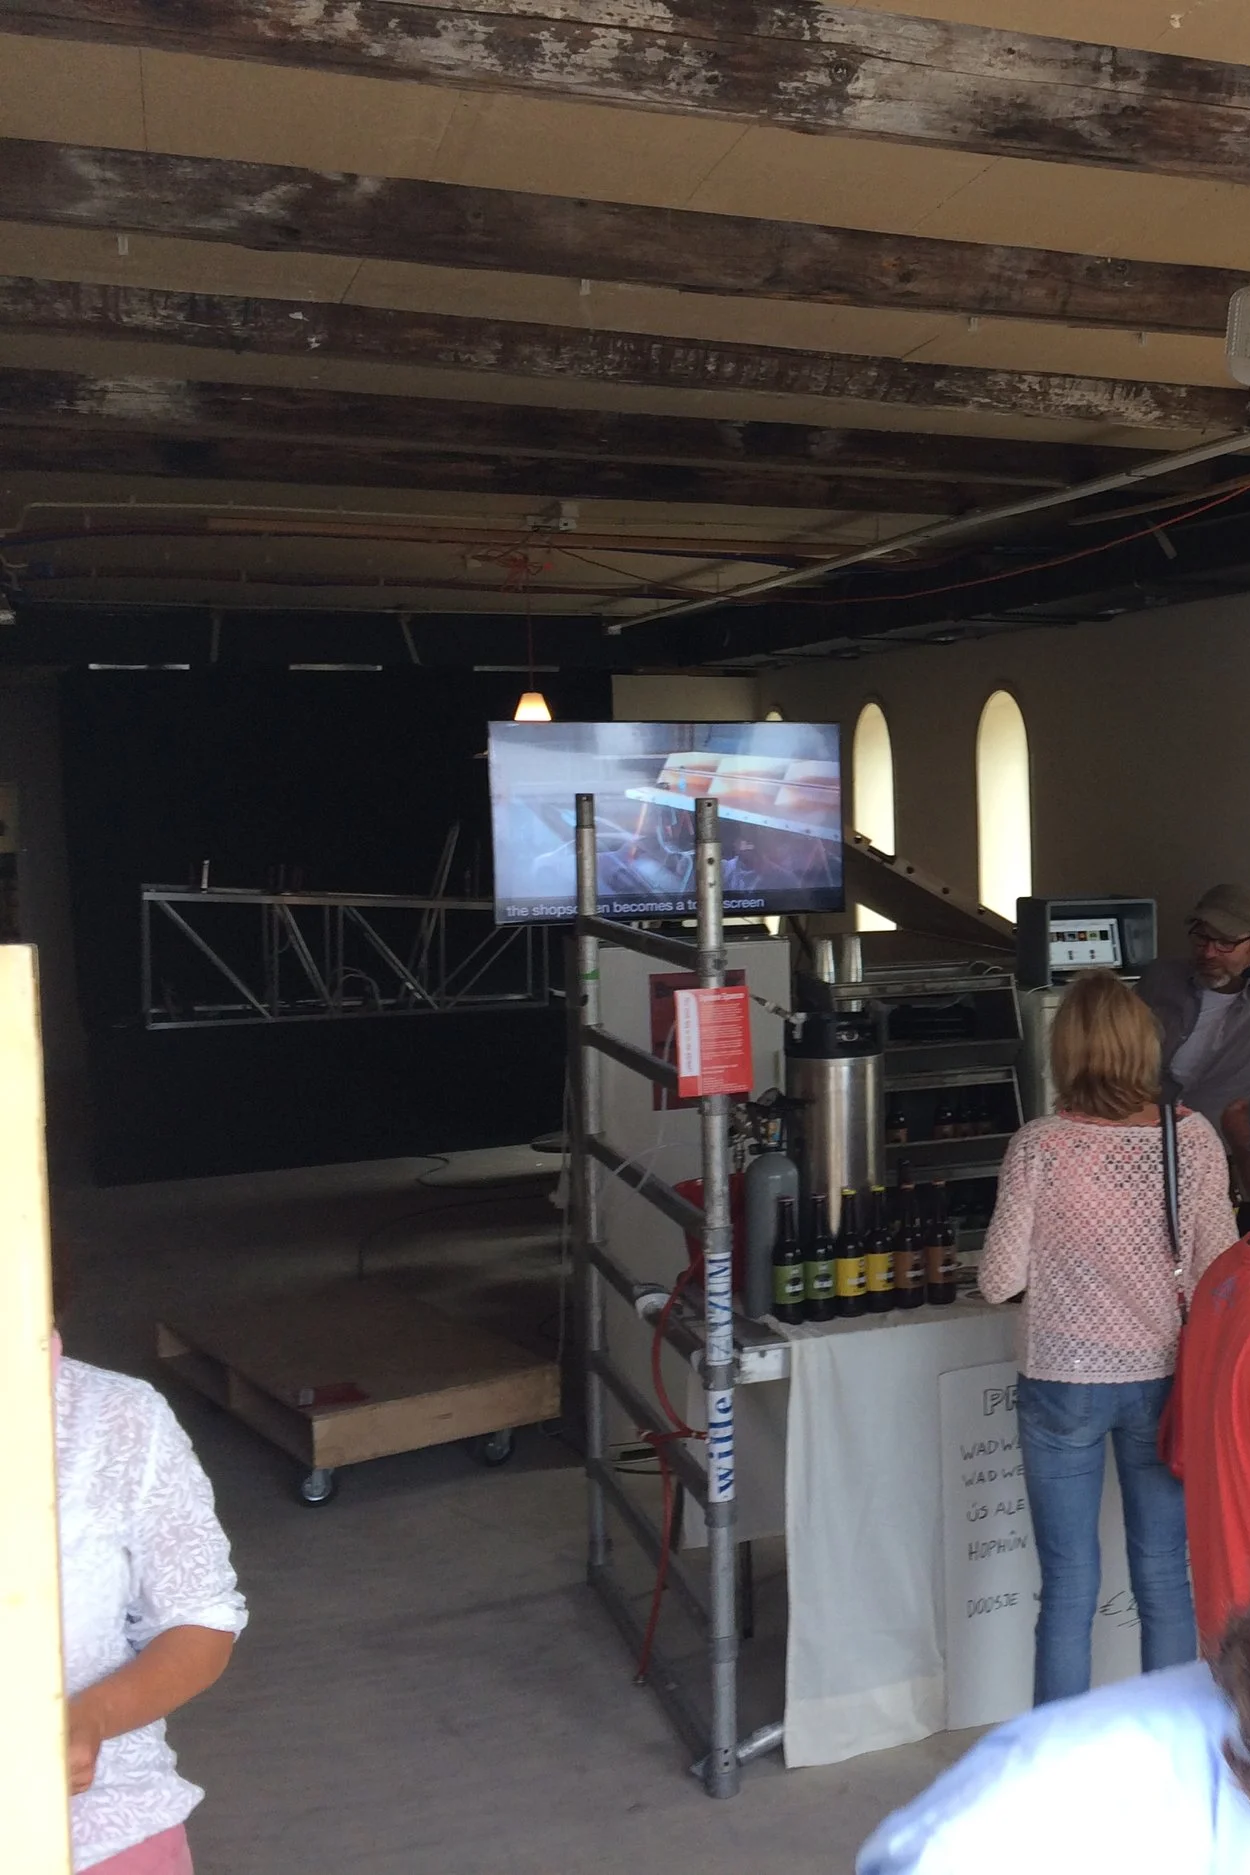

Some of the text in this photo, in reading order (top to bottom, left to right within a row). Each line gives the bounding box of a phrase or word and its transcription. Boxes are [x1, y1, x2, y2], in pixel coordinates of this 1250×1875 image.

[506, 904, 529, 917] the
[613, 901, 673, 914] becomes
[676, 902, 685, 911] a
